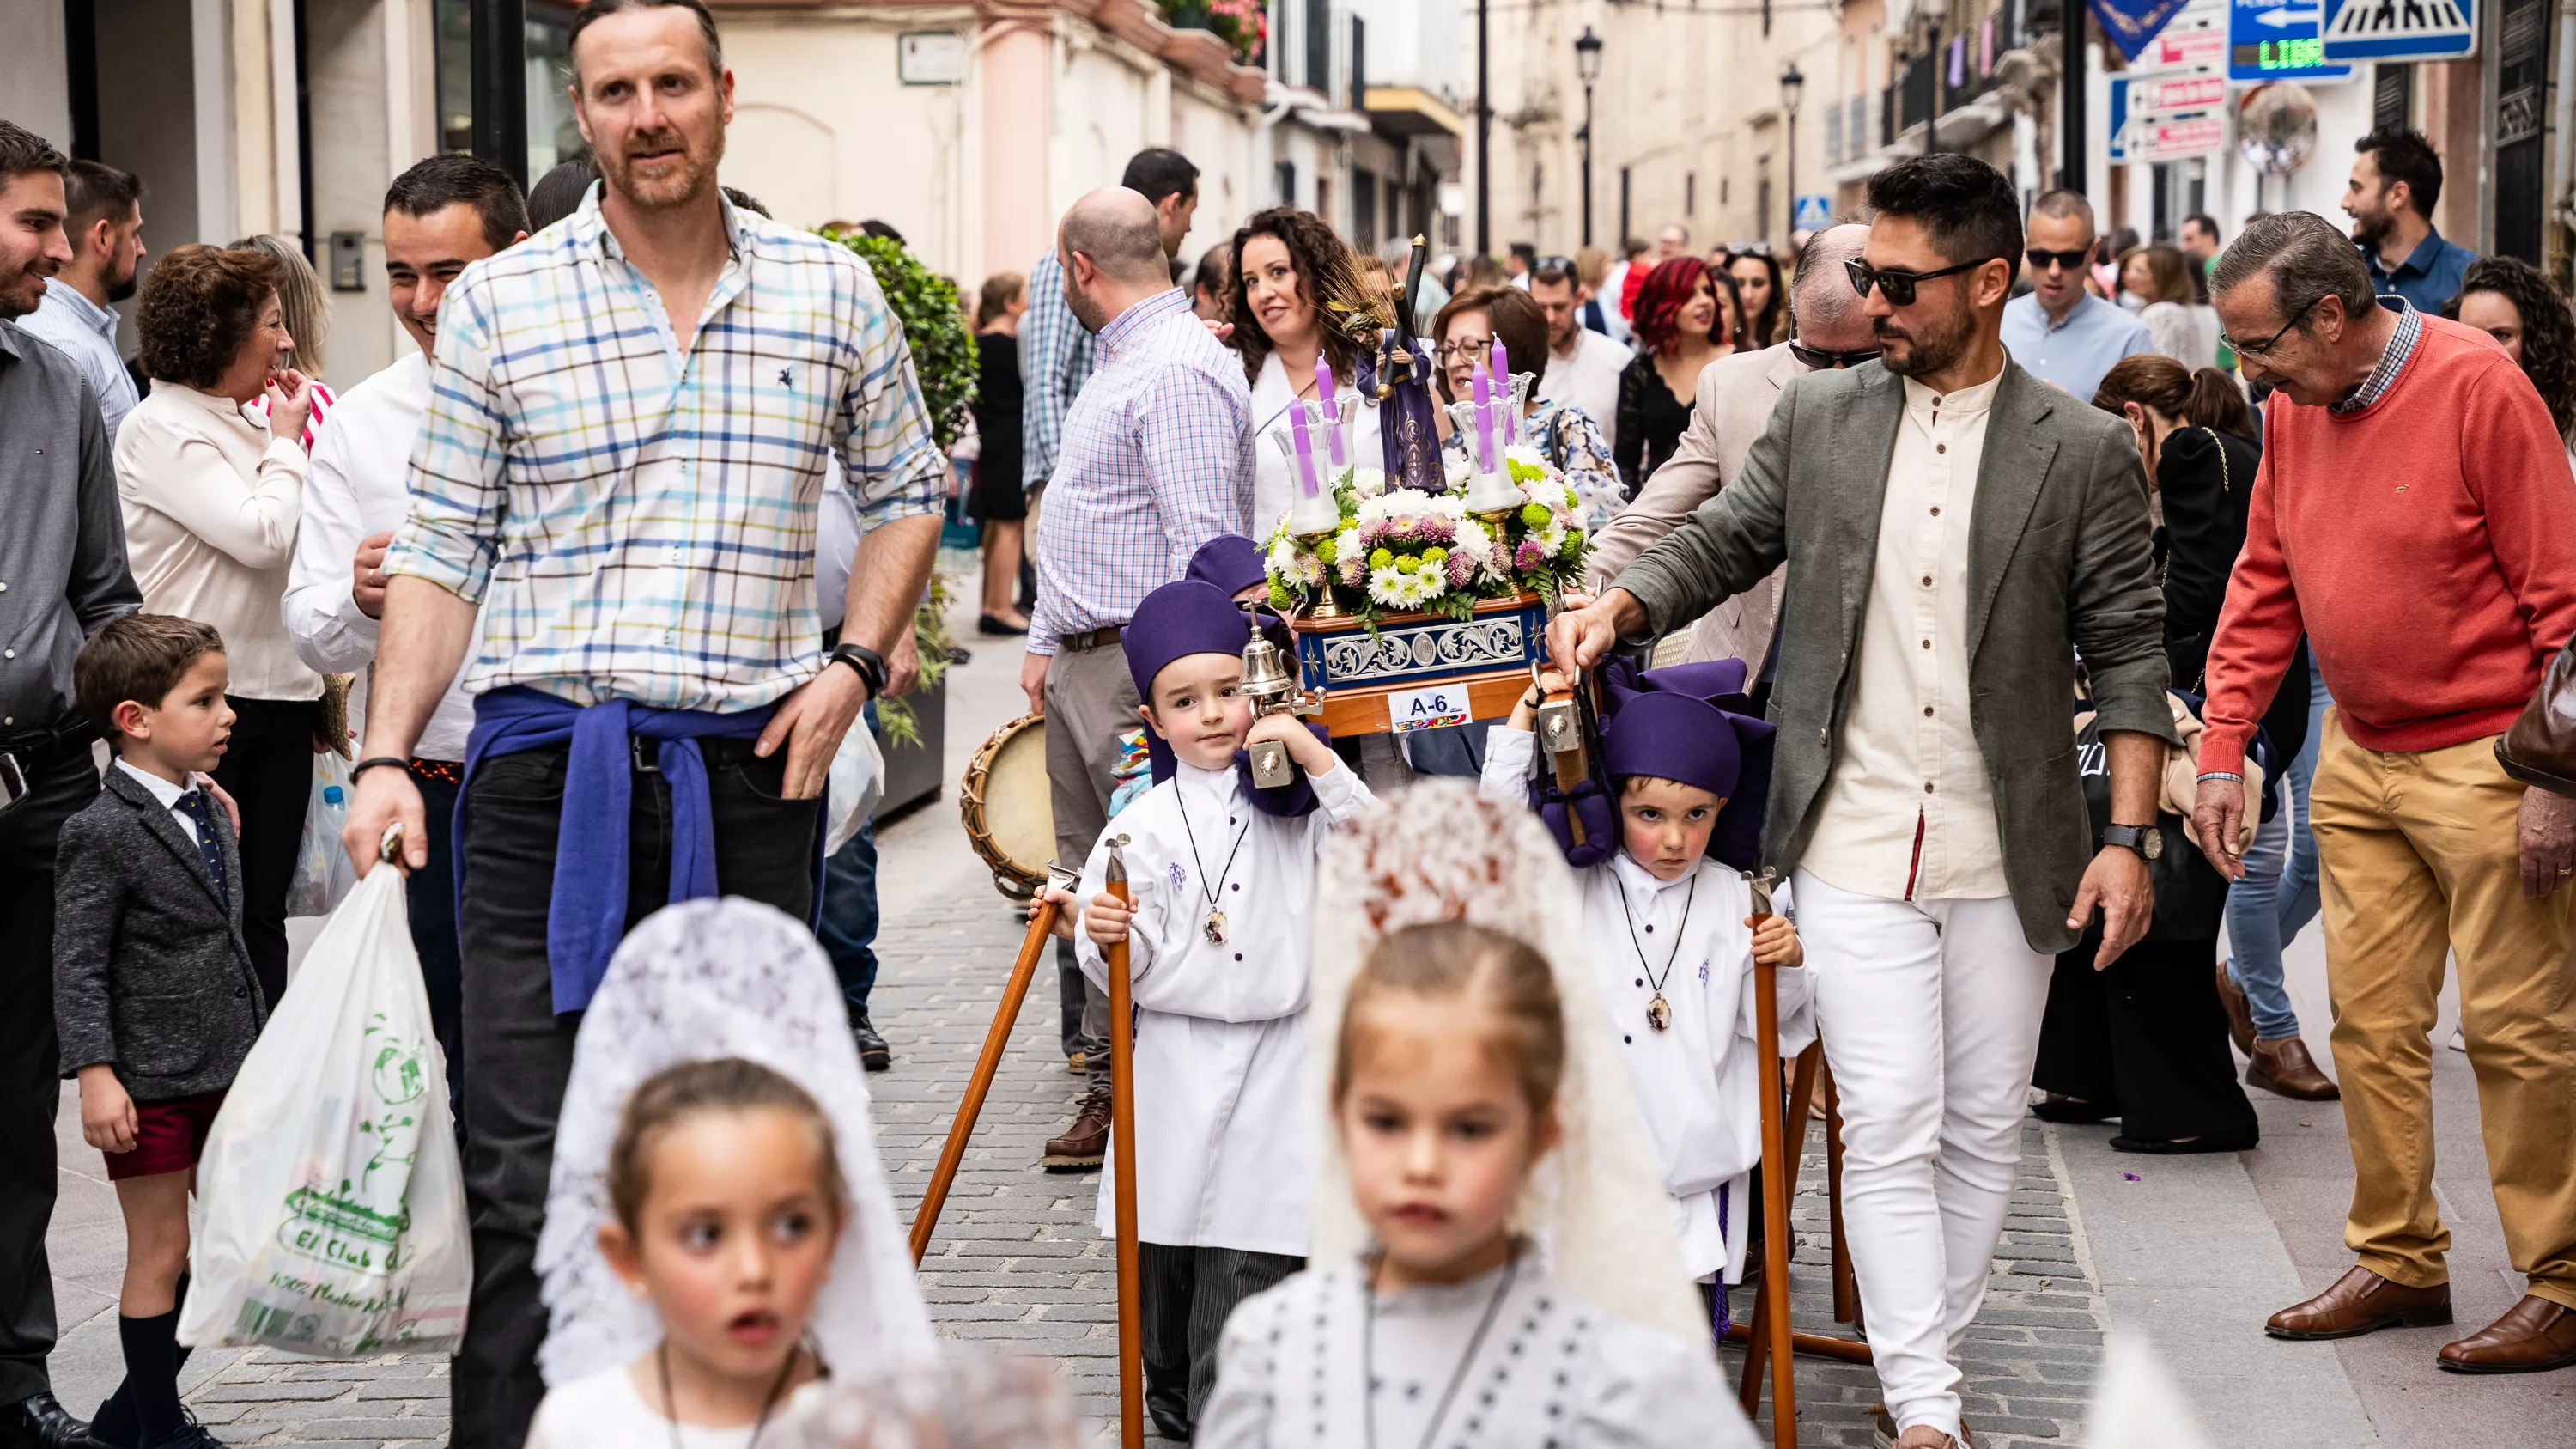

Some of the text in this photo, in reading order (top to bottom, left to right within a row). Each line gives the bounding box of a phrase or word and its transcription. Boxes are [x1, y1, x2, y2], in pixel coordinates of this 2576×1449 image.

[1411, 695, 1447, 715] A-6
[296, 1229, 370, 1268] El Club
